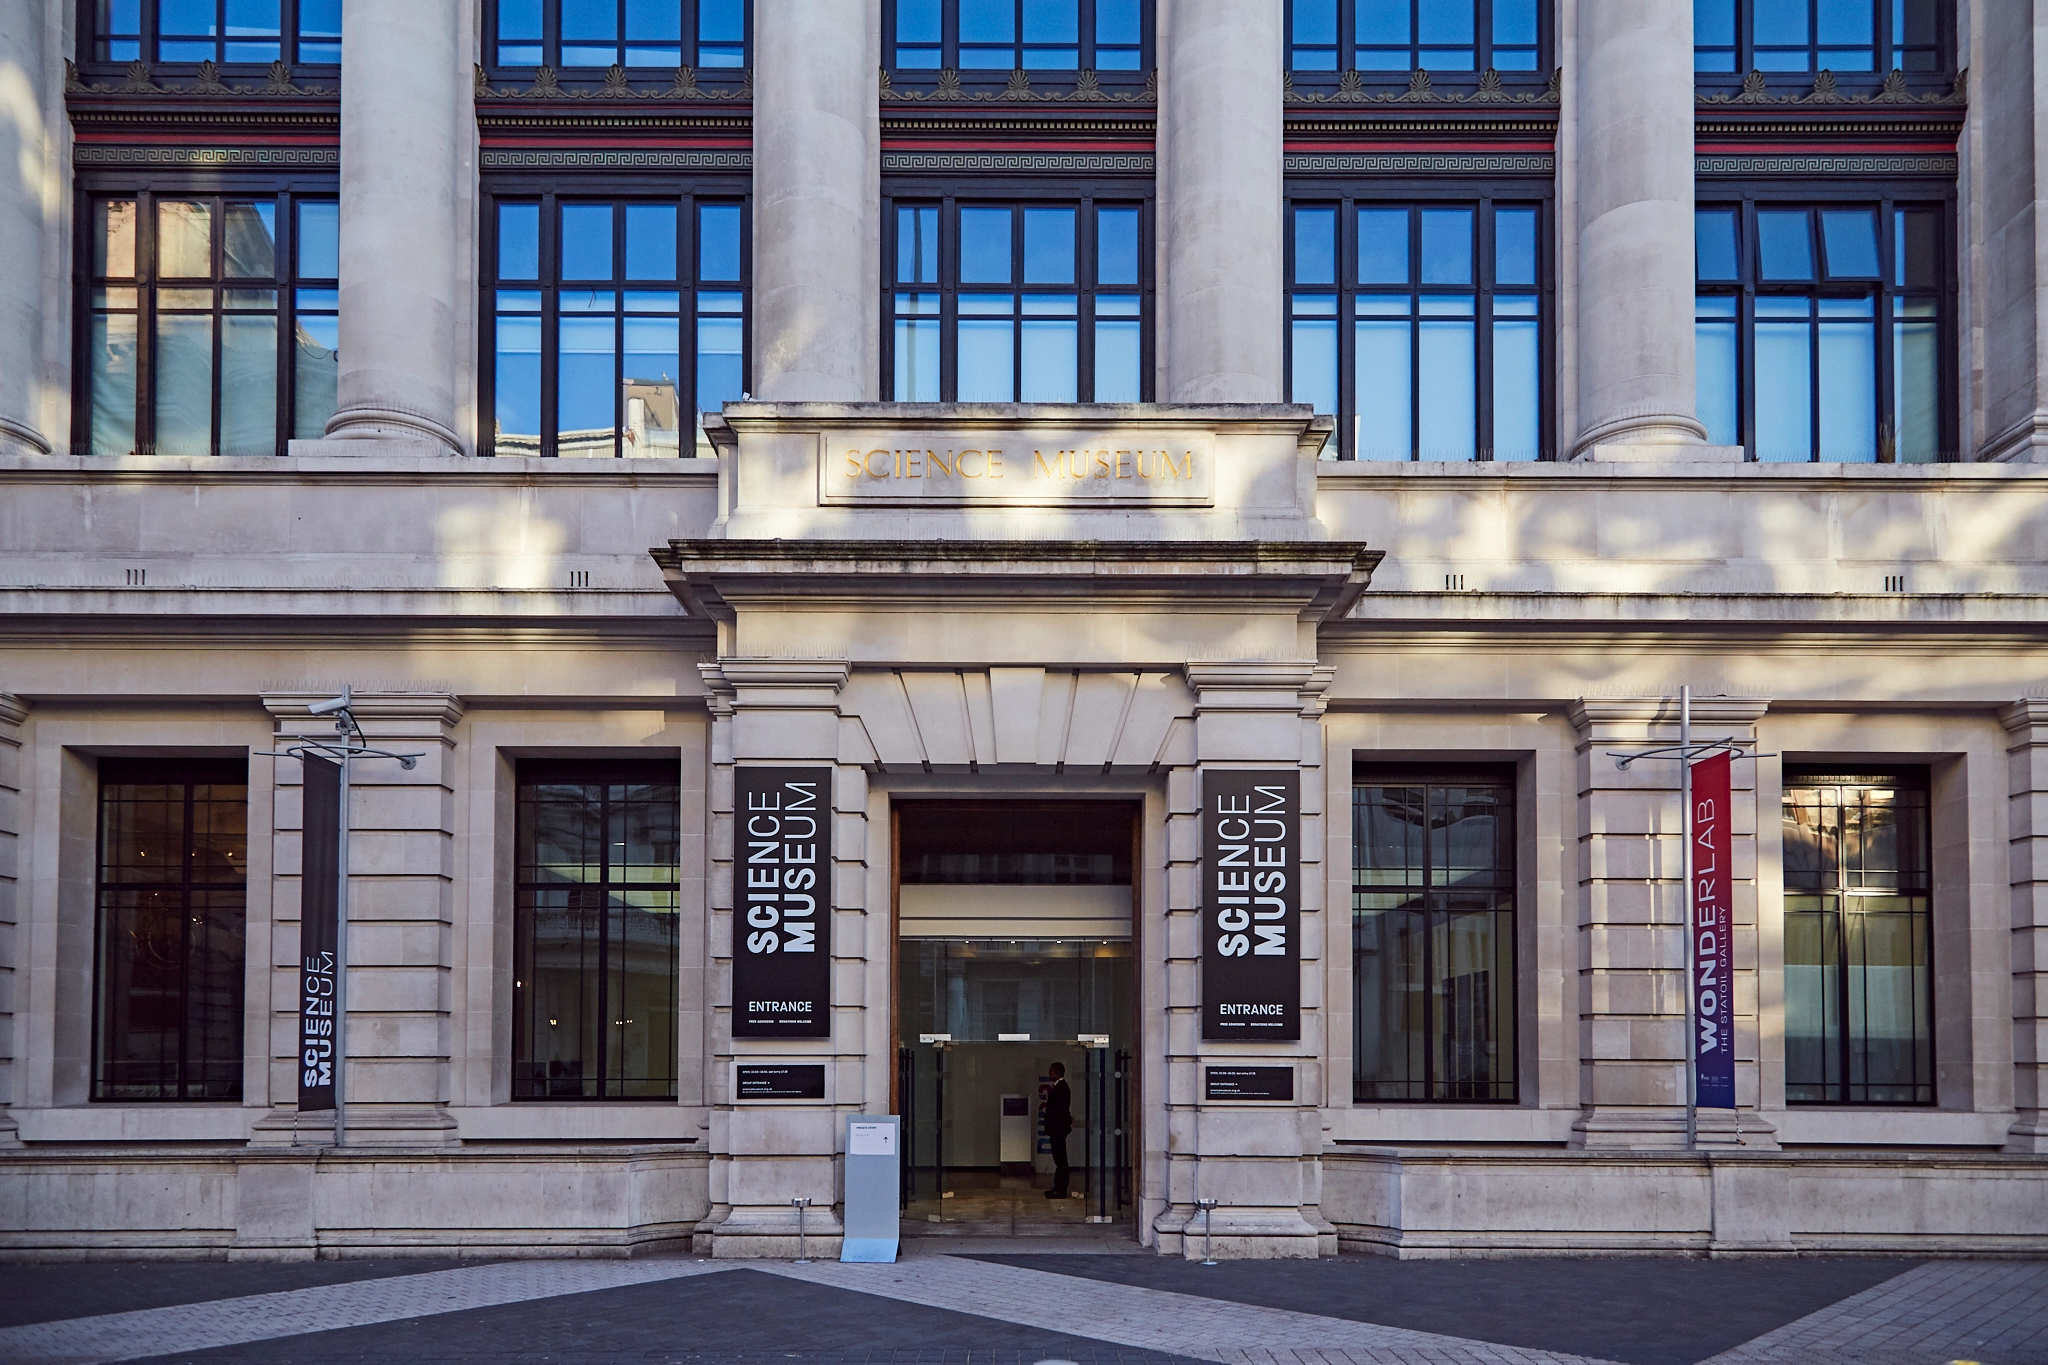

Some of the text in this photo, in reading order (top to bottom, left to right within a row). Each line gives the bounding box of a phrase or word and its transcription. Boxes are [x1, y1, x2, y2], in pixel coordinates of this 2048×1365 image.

[845, 449, 1193, 480] SCIENCE MUSEUM
[747, 791, 780, 954] SCIENCE
[783, 782, 817, 953] MUSEUM
[1217, 794, 1250, 957] SCIENCE
[1253, 785, 1286, 956] MUSEUM
[1697, 798, 1718, 1054] WONDERLAB
[1719, 906, 1727, 967] GALLERY
[1720, 971, 1728, 1025] STATOIL
[304, 956, 320, 1088] SCIENCE
[318, 951, 334, 1086] MUSEUM
[748, 1001, 812, 1012] ENTRANCE
[1220, 1004, 1284, 1015] ENTRANCE
